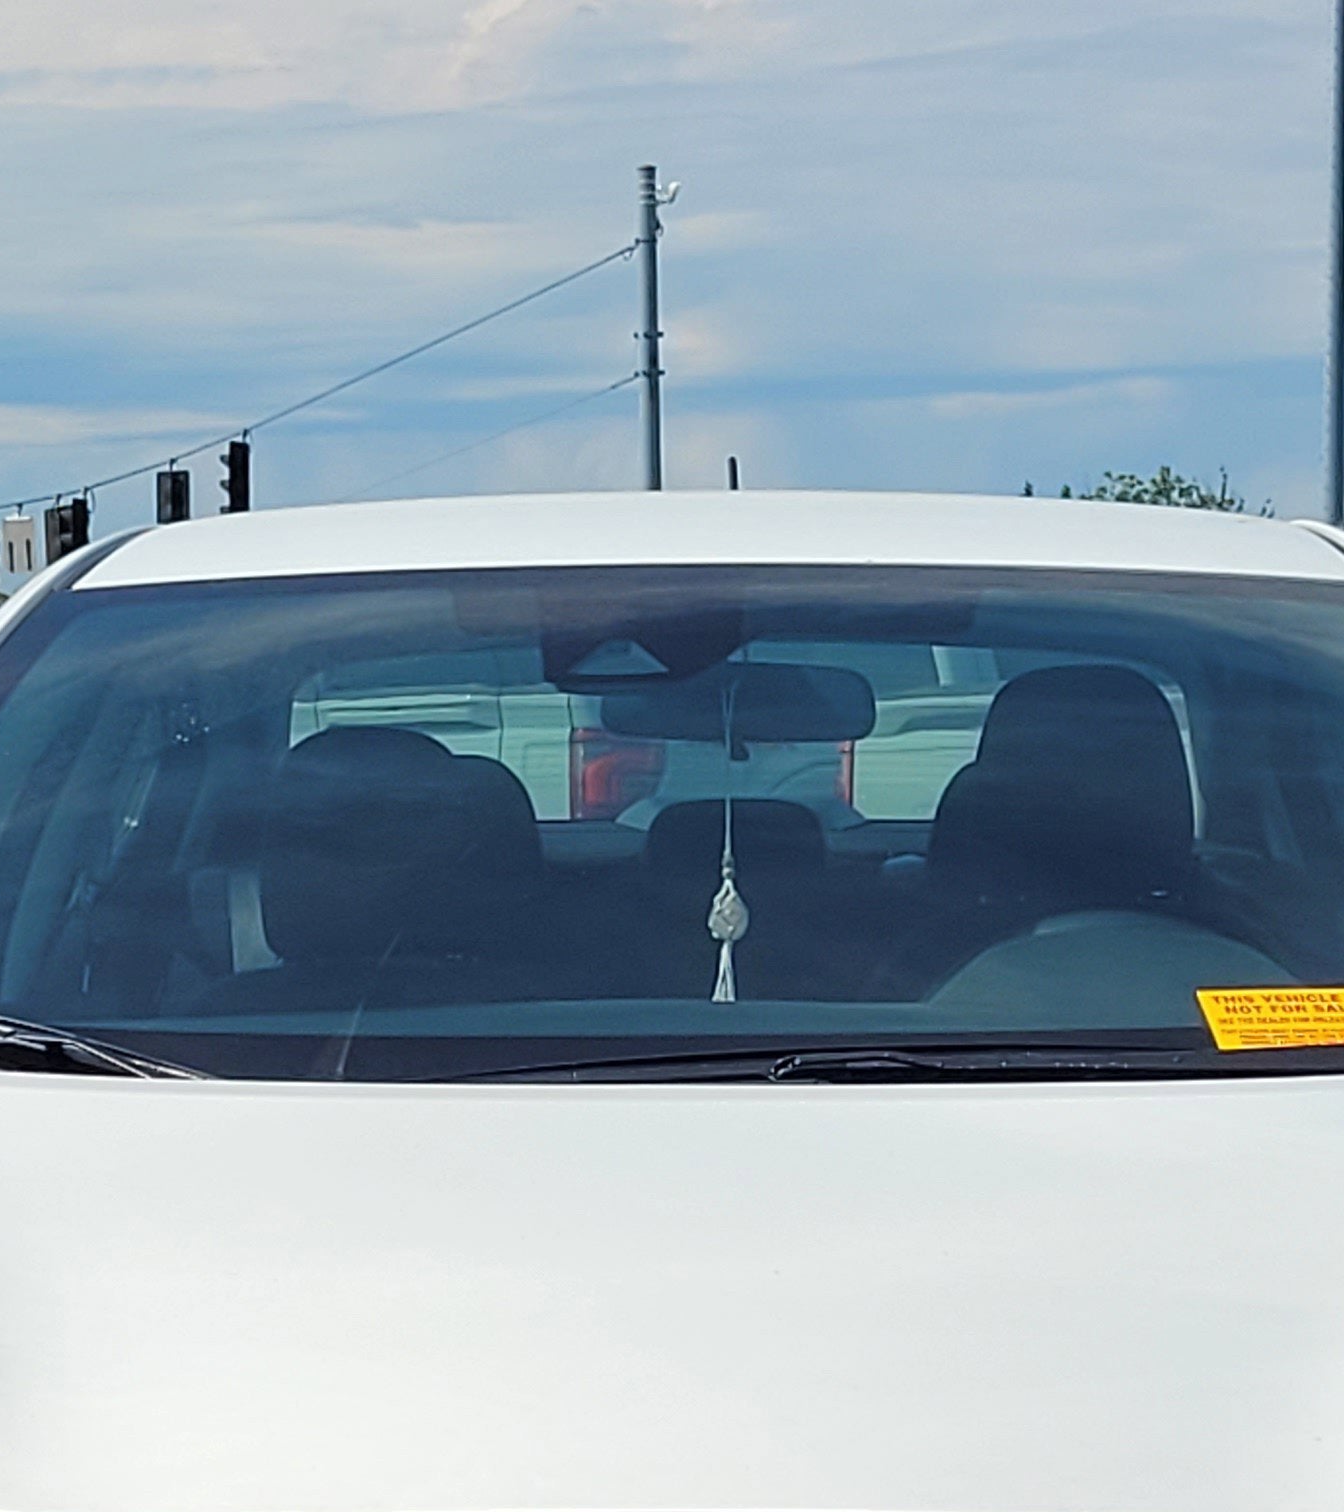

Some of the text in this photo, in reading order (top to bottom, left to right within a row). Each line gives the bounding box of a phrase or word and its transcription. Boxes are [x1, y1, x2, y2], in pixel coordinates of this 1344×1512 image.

[1212, 995, 1254, 1004] THIS
[1261, 994, 1341, 1003] VEHICLE
[1225, 1005, 1261, 1014] NOT
[1270, 1005, 1307, 1013] FOR
